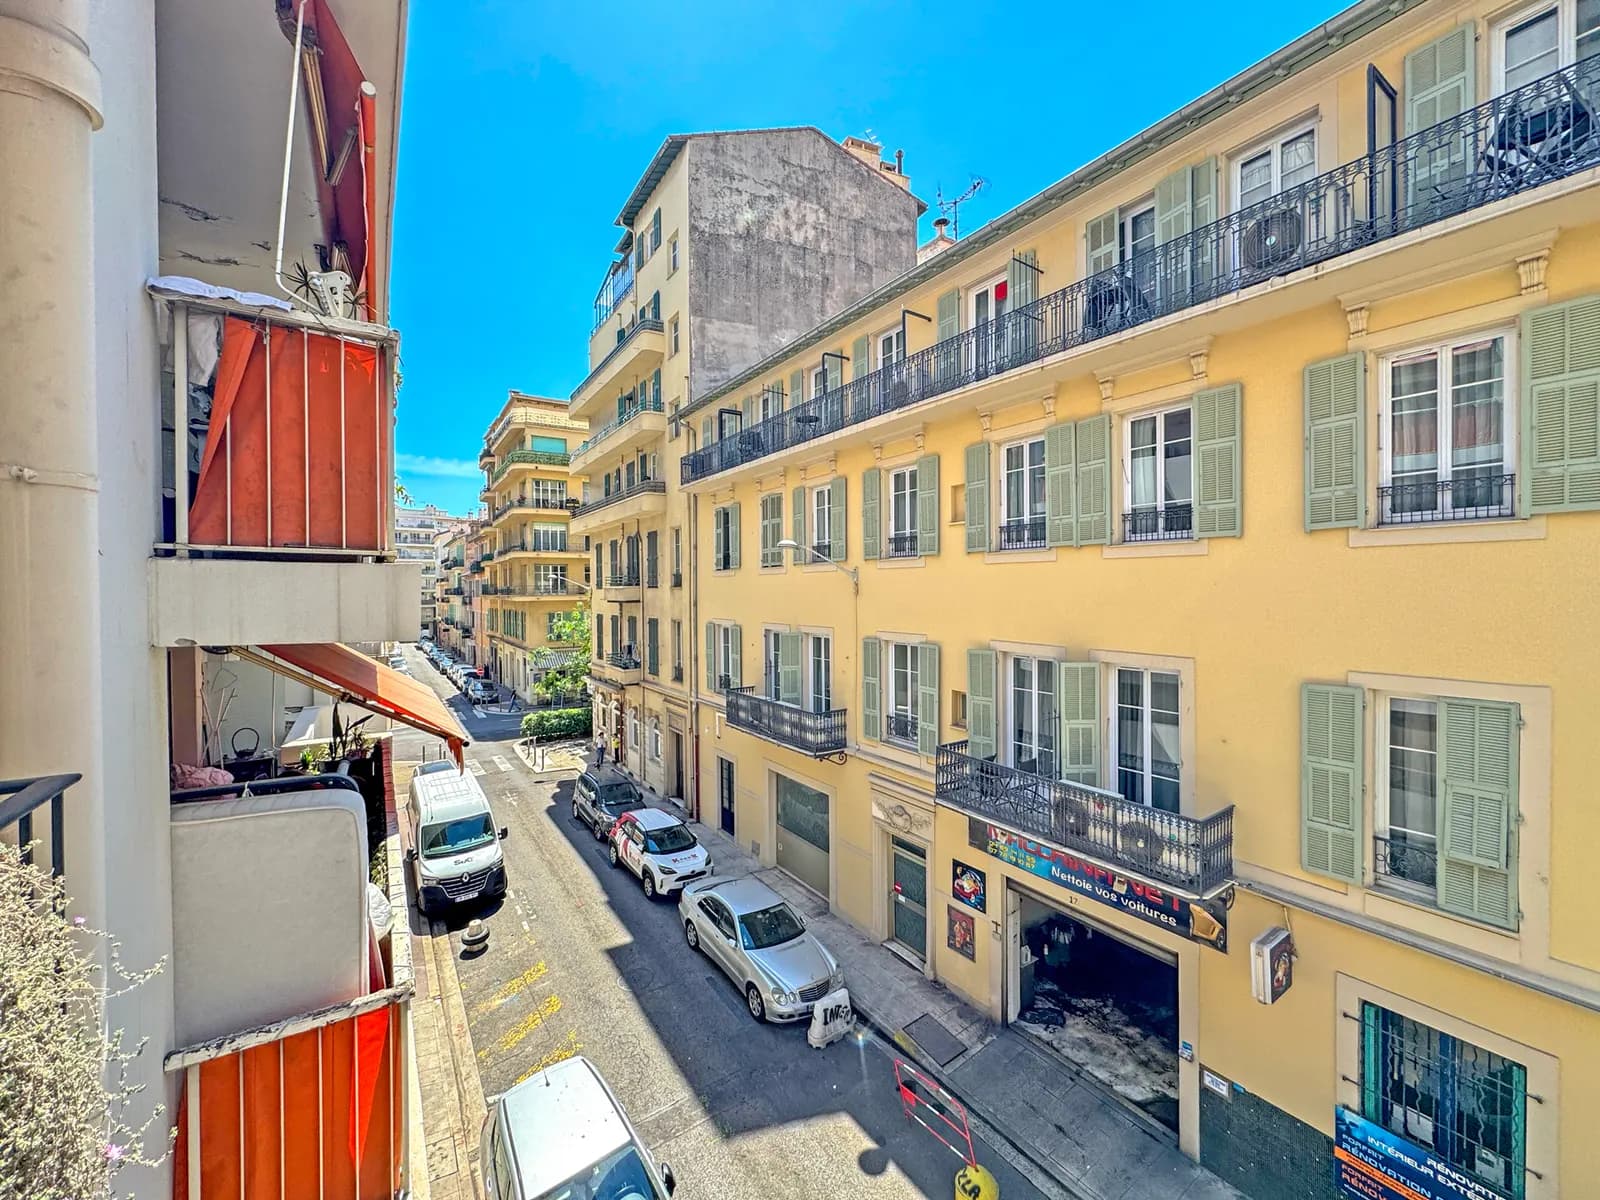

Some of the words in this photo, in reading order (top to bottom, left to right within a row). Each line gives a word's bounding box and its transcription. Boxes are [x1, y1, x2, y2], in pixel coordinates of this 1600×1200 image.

[1051, 866, 1093, 892] Nettoie
[1095, 886, 1118, 902] vos
[1120, 897, 1177, 927] voitures
[1342, 1133, 1384, 1161] FORFAIT
[1367, 1135, 1434, 1178] INTÉRIEUR
[1341, 1163, 1384, 1192] FORFAIT
[1342, 1141, 1431, 1199] RÉNOVATION
